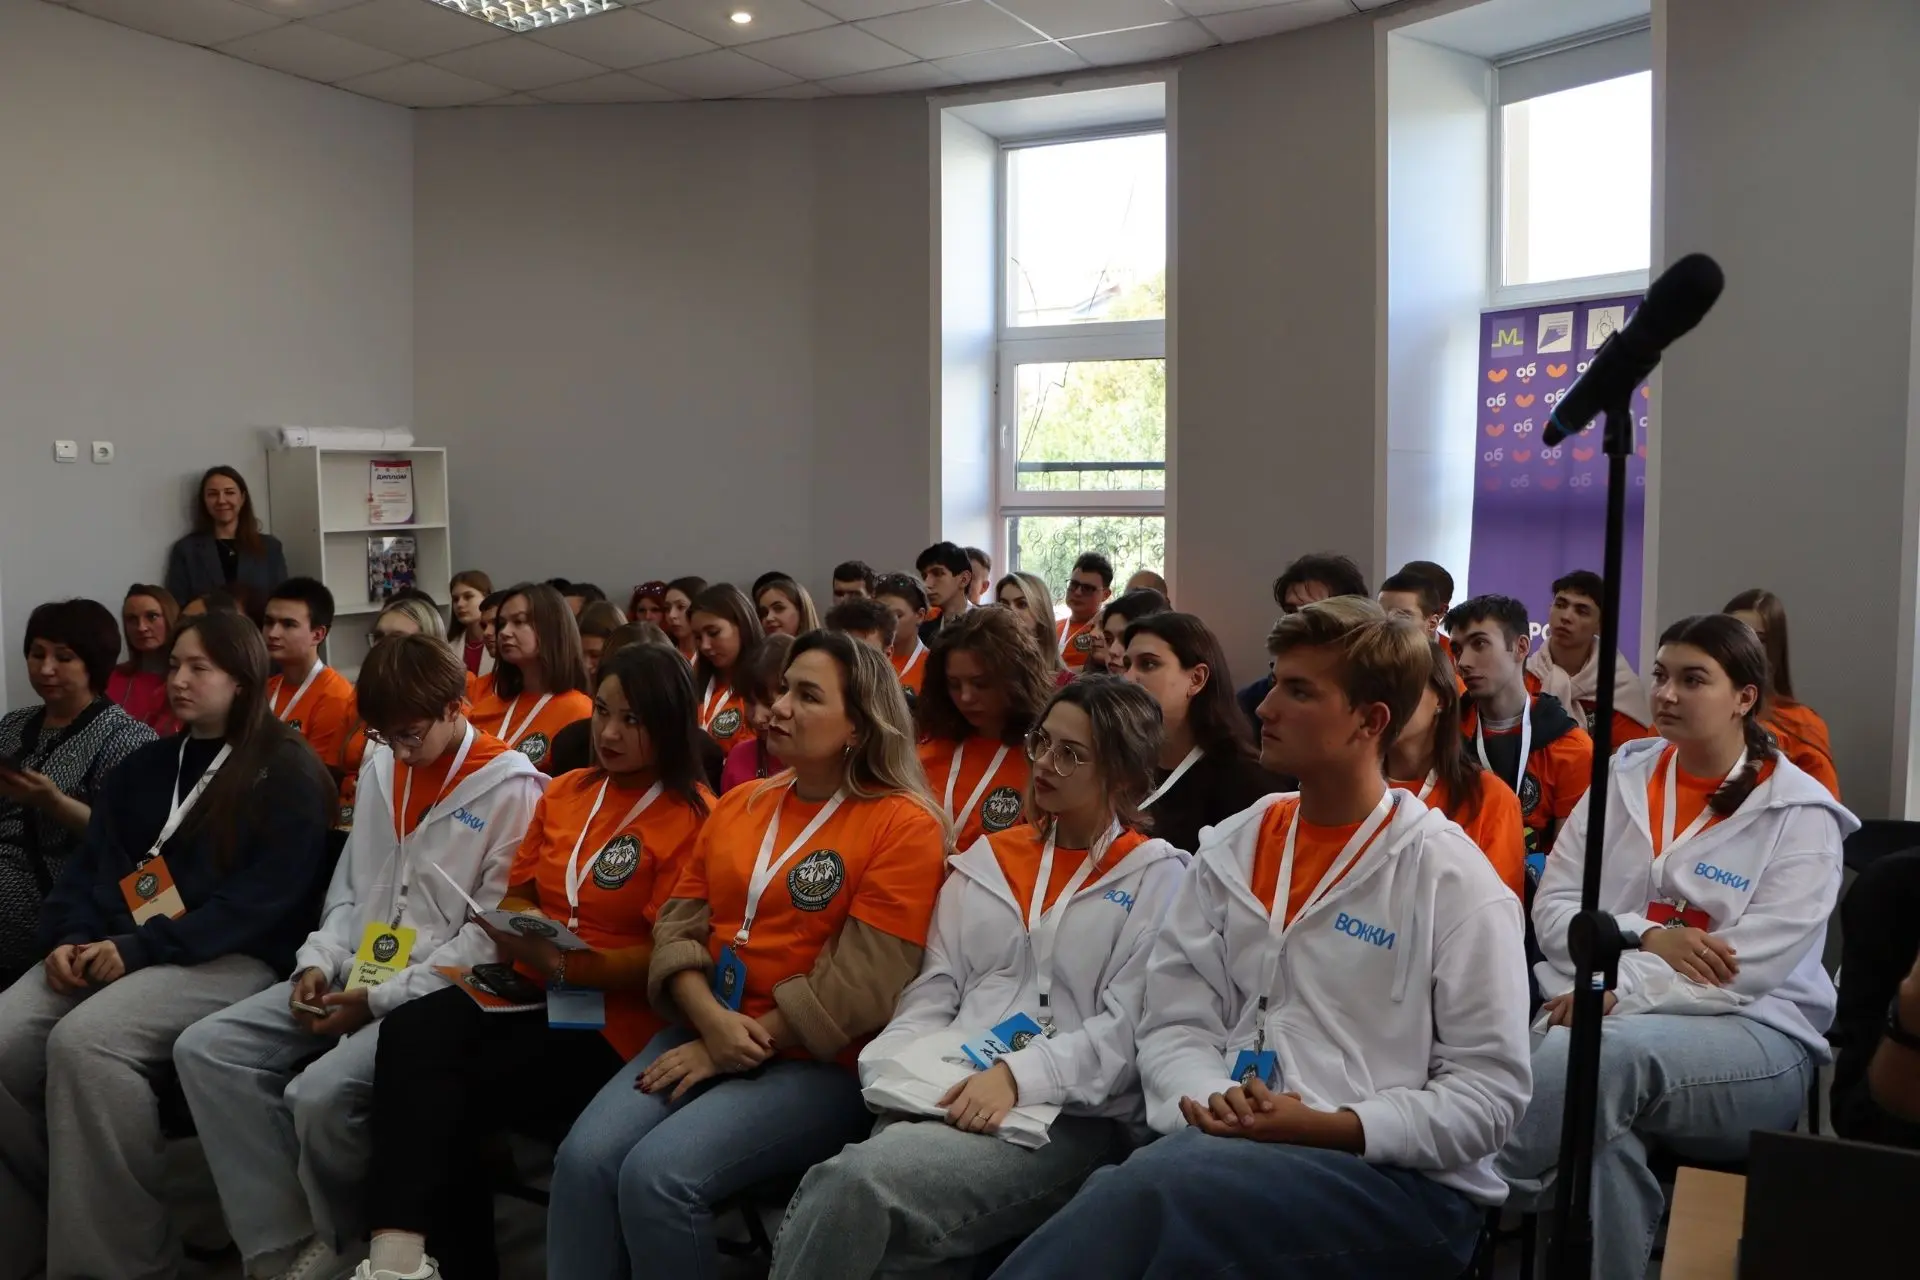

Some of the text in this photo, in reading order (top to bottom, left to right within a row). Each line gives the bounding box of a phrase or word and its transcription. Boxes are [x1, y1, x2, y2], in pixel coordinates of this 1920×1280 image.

[1516, 362, 1537, 378] об
[1486, 393, 1507, 407] об
[1513, 418, 1533, 433] об
[1484, 444, 1562, 462] об об
[453, 807, 485, 832] ОККИ
[1694, 862, 1751, 892] ВОККИ
[1103, 889, 1136, 912] ВОК
[1334, 912, 1395, 950] ВОККИ
